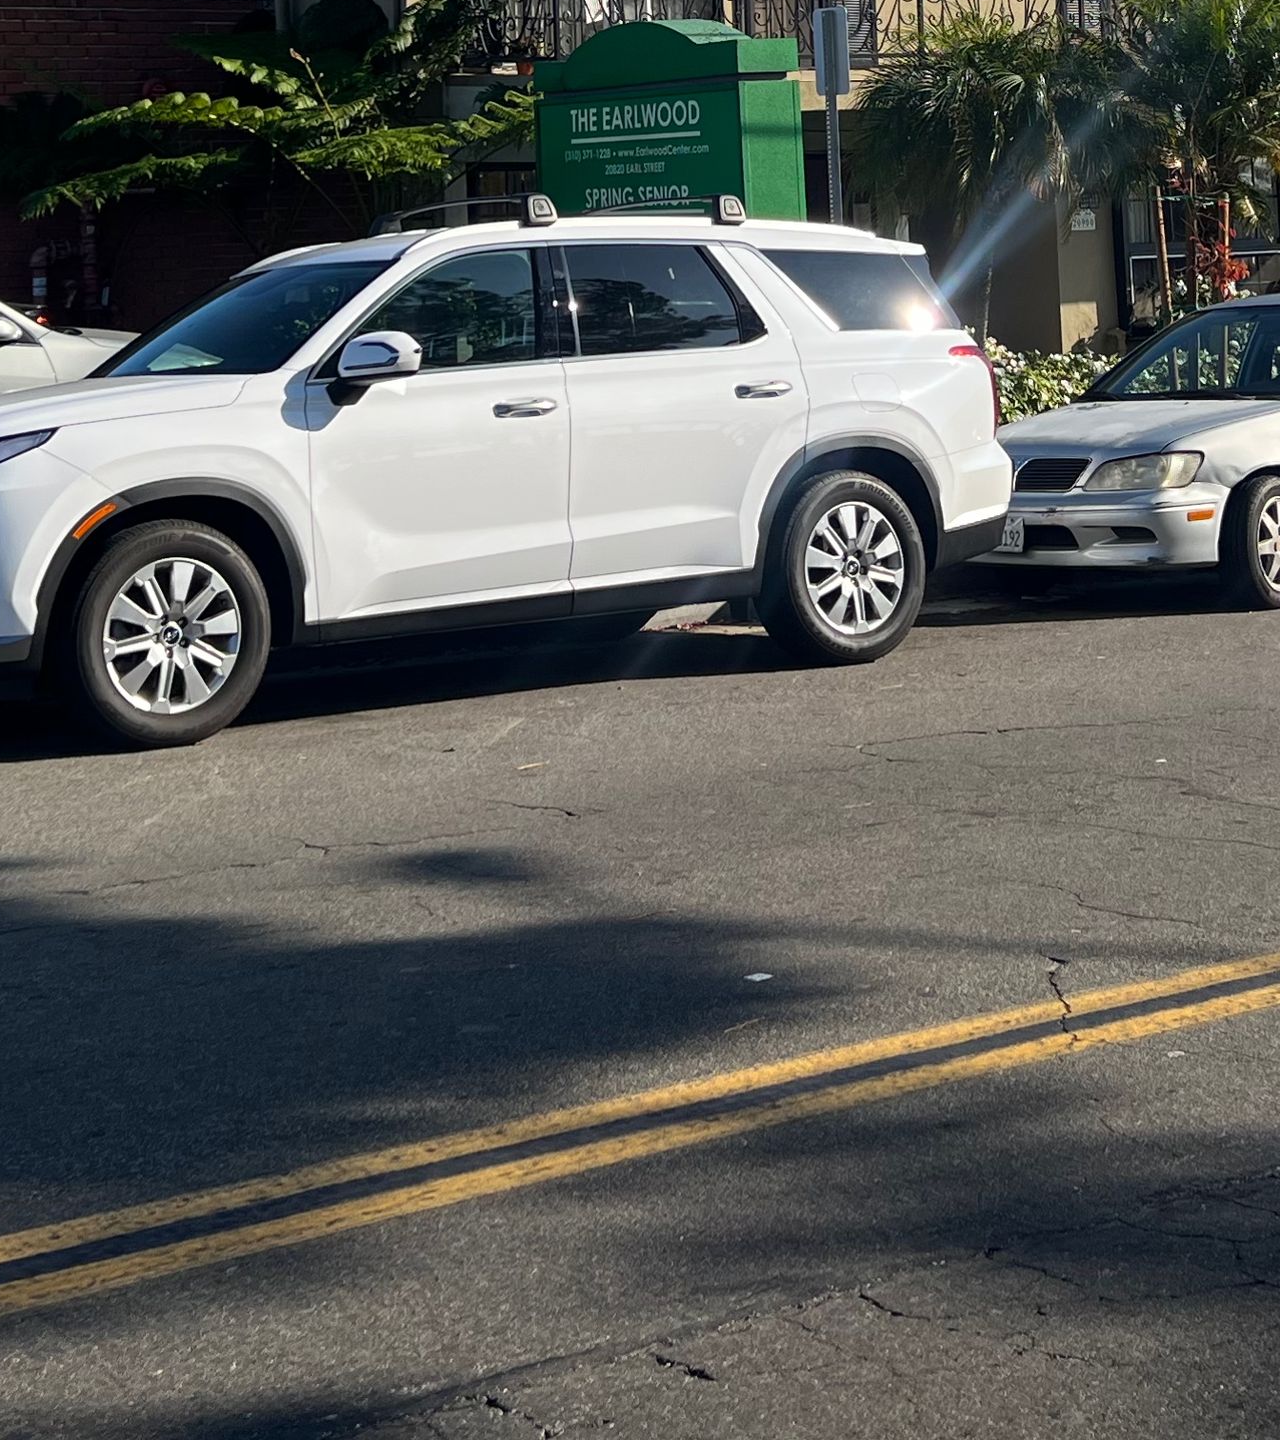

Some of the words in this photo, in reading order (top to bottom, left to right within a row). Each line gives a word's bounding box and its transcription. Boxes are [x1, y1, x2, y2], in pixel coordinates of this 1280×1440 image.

[570, 108, 598, 133] THE
[602, 100, 700, 131] EARLWOOD
[618, 144, 710, 157] www.EarlwoodCenter.com
[626, 163, 642, 174] EARL
[643, 161, 665, 173] STREET
[585, 187, 634, 209] SPRING
[638, 185, 690, 206] SENIOR
